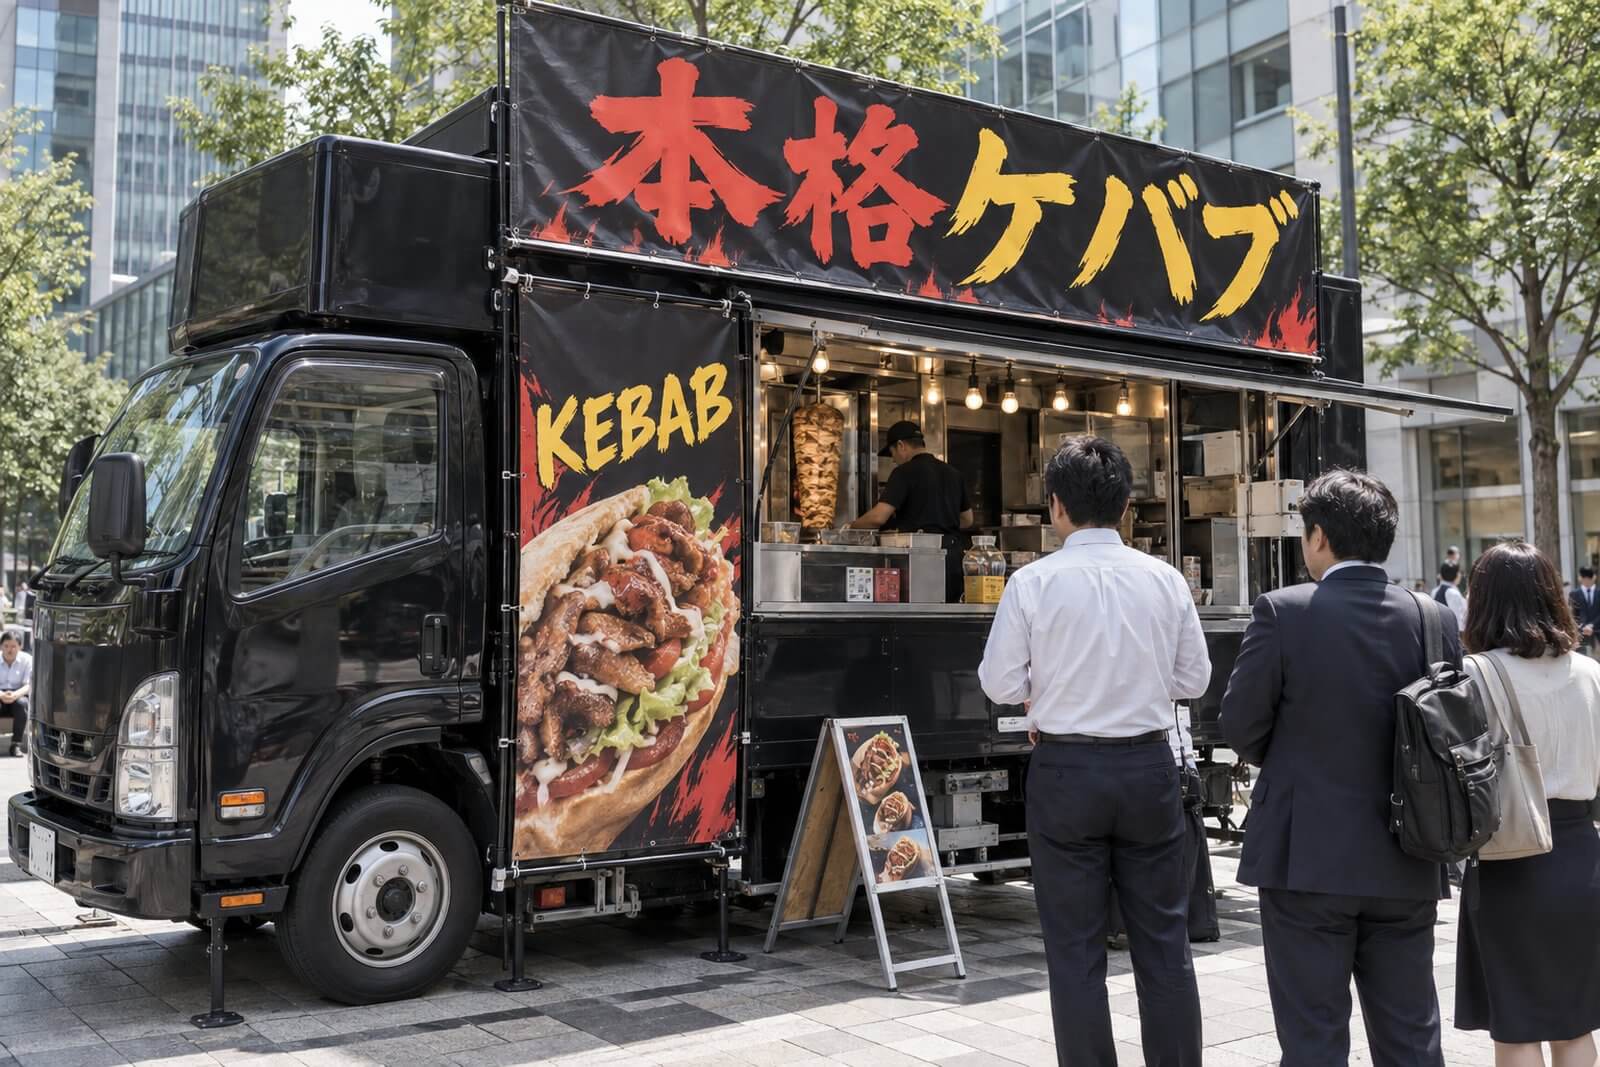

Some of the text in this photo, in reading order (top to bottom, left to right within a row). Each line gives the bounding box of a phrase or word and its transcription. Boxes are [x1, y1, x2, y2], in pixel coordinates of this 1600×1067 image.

[562, 57, 1298, 321] 本格ケバブ
[536, 363, 734, 489] KEBAB
